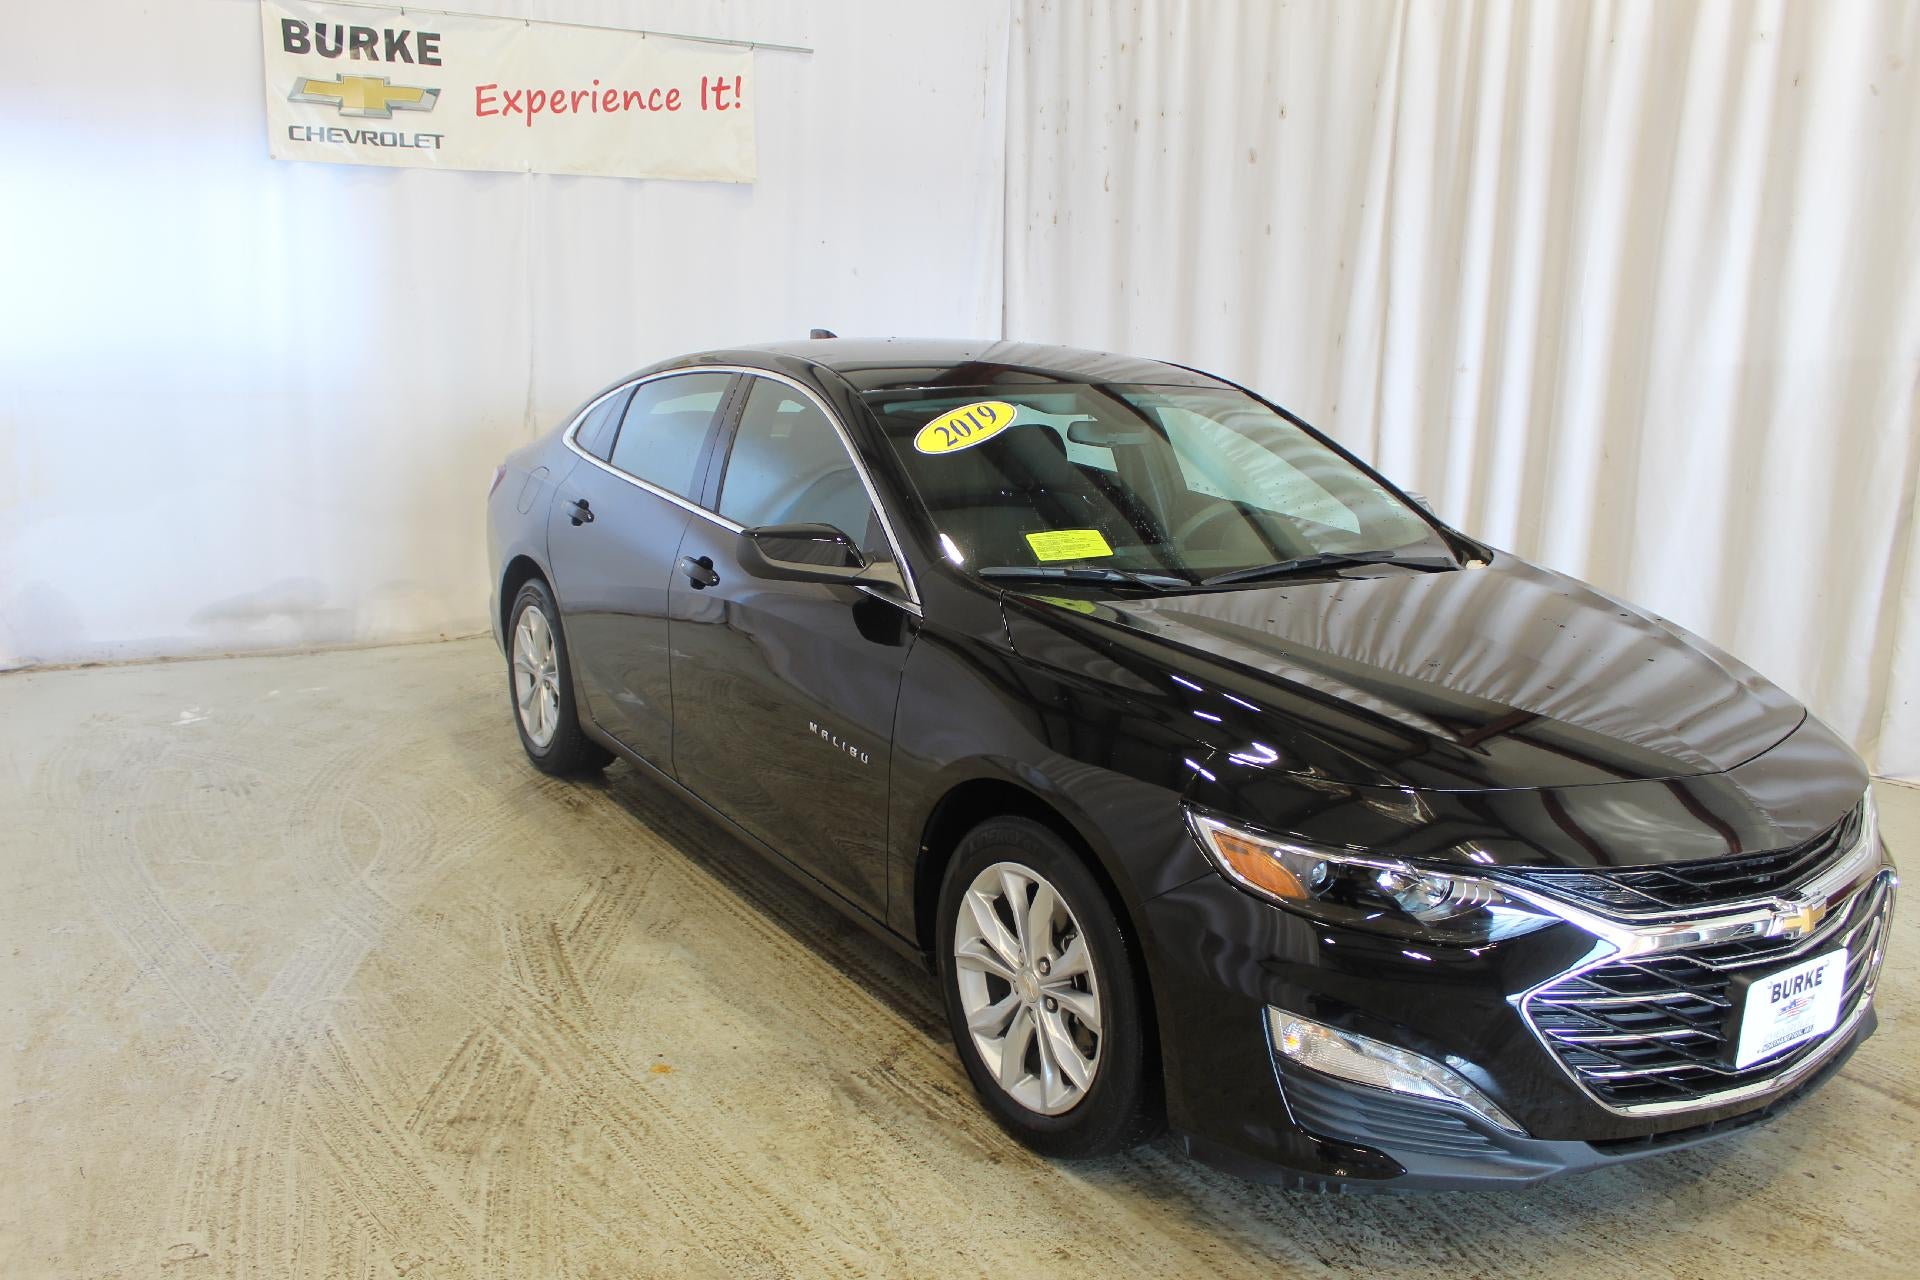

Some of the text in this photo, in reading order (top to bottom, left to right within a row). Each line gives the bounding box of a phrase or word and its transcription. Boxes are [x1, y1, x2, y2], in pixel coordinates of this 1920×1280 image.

[281, 18, 442, 66] BURKE
[475, 75, 742, 127] Experience It!
[288, 125, 445, 149] CHEVROLET
[934, 405, 996, 446] 2019
[809, 721, 869, 764] MALIBU
[1771, 965, 1825, 1003] BURKE
